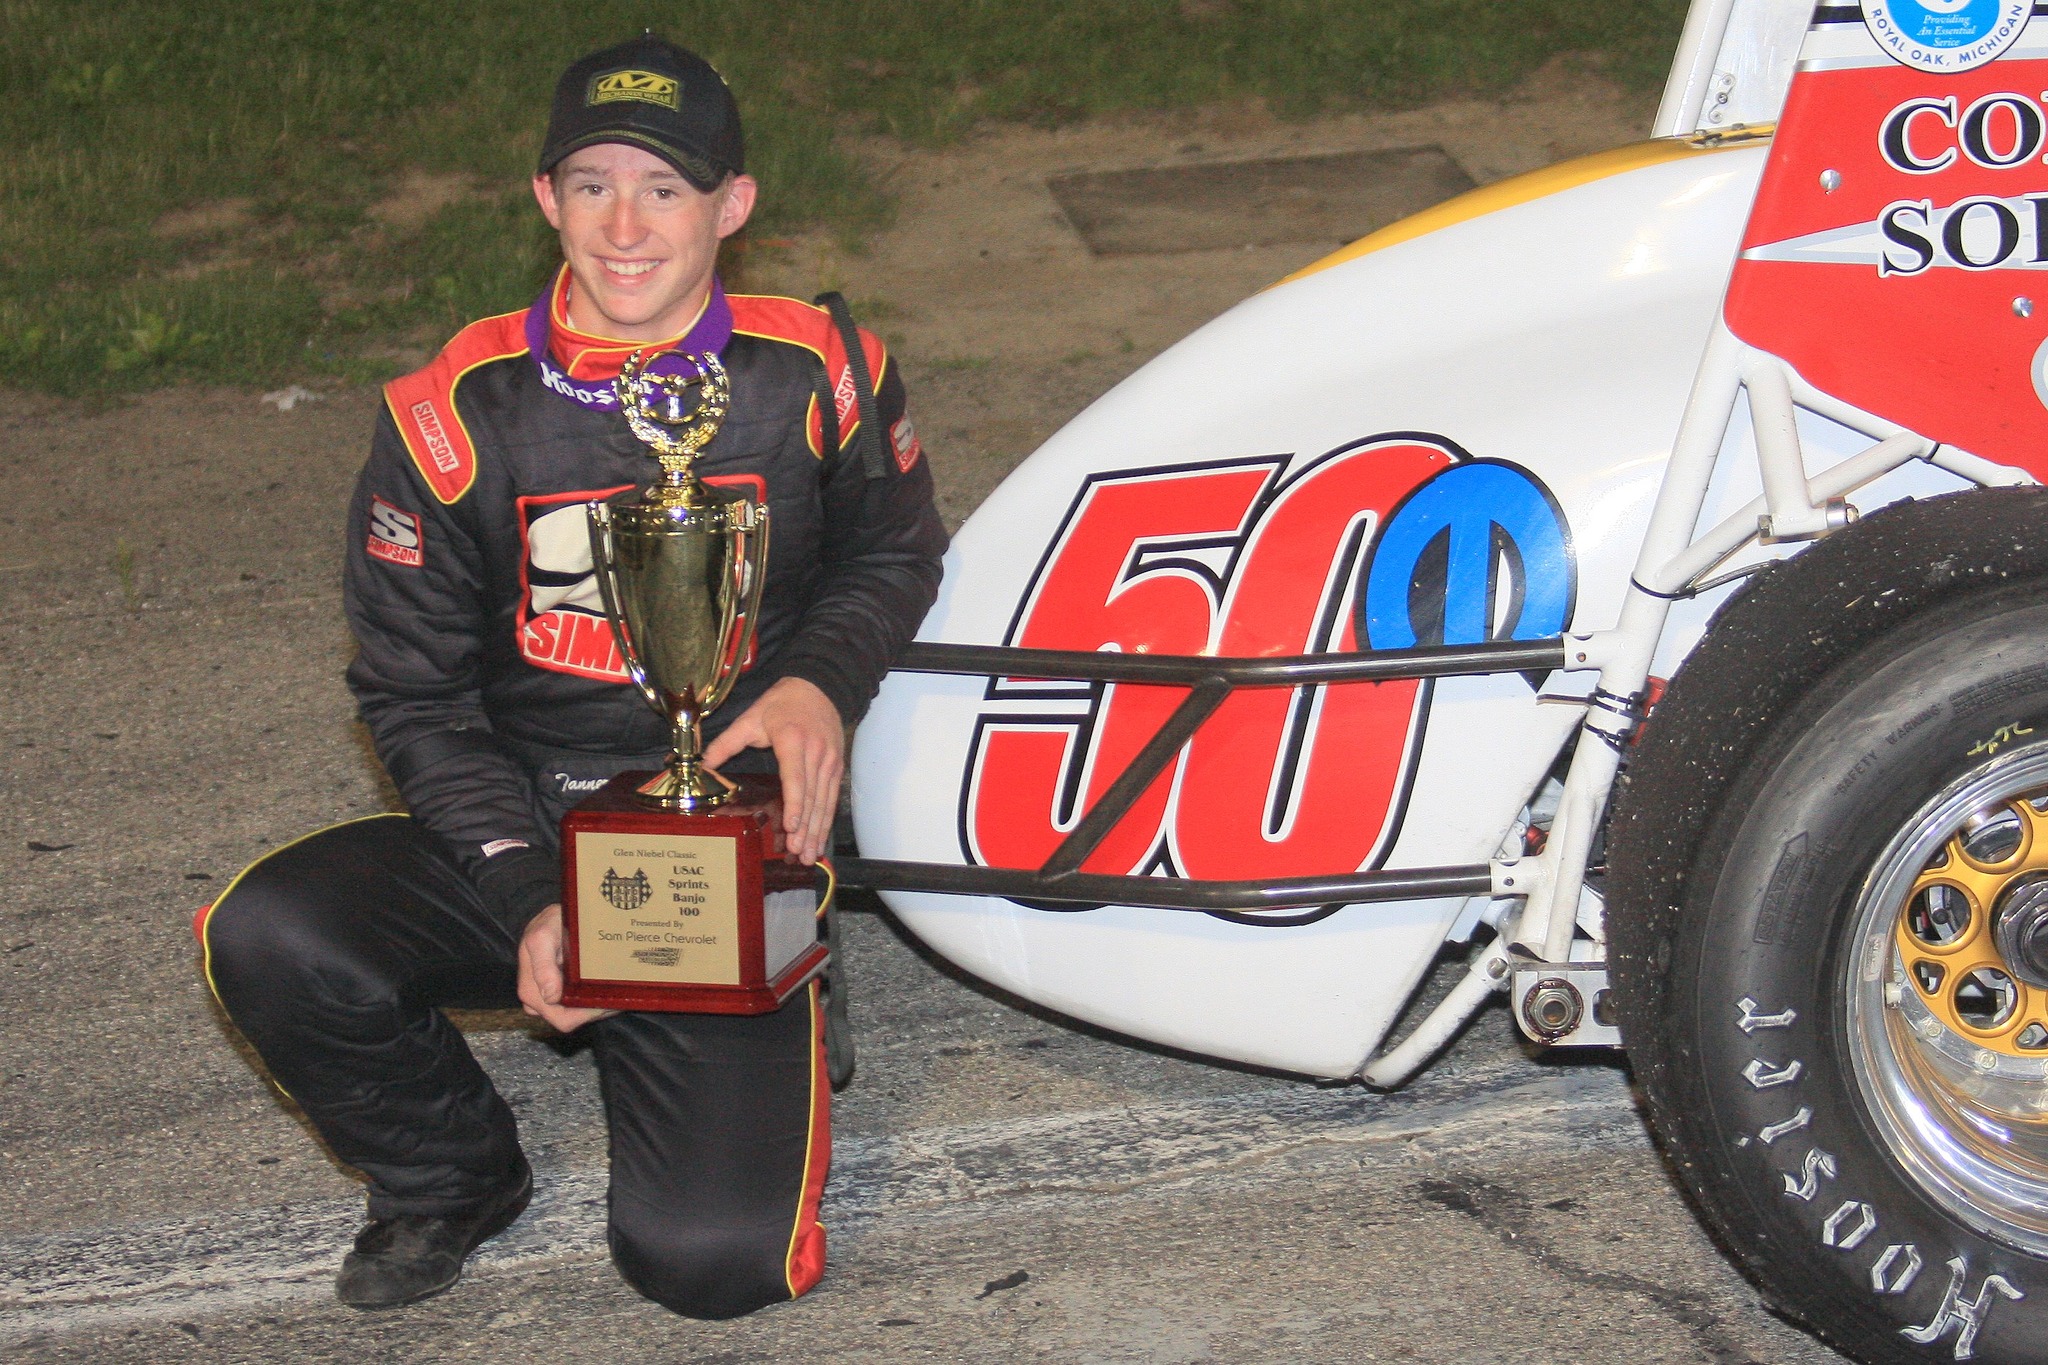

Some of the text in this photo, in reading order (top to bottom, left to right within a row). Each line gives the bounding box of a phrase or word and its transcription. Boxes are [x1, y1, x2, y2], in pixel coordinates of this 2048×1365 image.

[1923, 14, 1971, 27] Providing
[1872, 9, 1904, 52] ROYAL
[1958, 4, 2023, 63] MICHIGAN
[1916, 26, 1977, 36] An Essential
[1880, 95, 2048, 173] CO
[415, 401, 457, 472] SIMPSON
[367, 534, 418, 563] SIMPSON
[957, 430, 1475, 927] 50
[613, 849, 697, 859] Glen Niebel Classic
[673, 865, 704, 876] USAC
[668, 879, 709, 890] Sprints
[673, 893, 705, 904] Banjo
[679, 907, 700, 916] 100
[631, 919, 684, 929] Presented By
[598, 930, 717, 945] Sam Pierce Chevrolet
